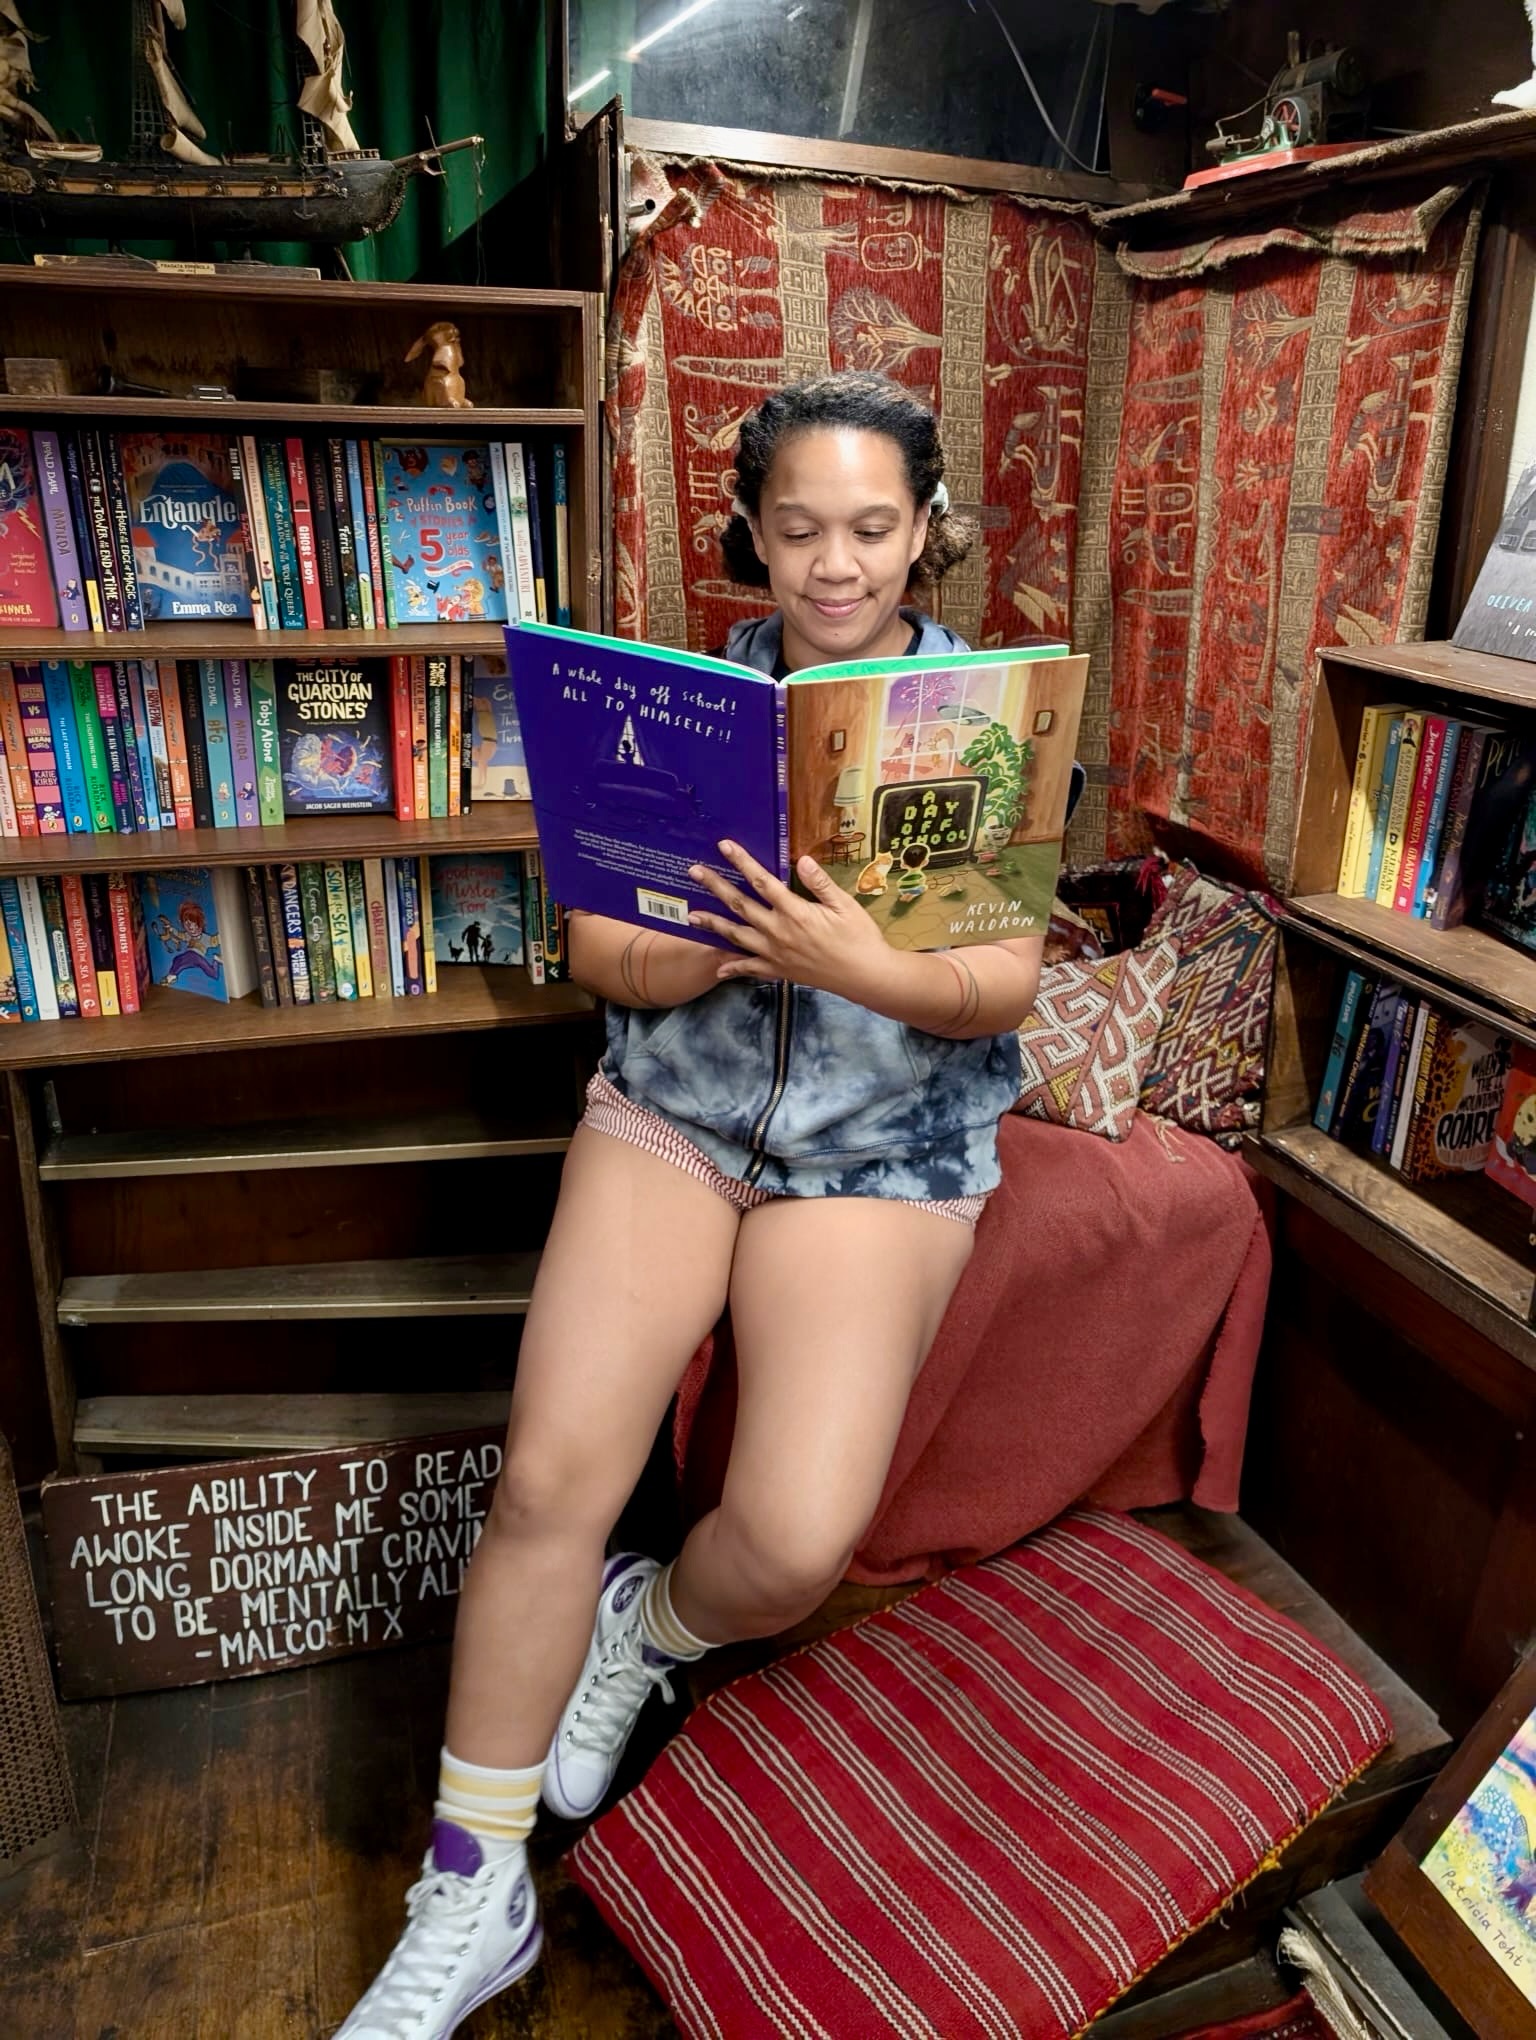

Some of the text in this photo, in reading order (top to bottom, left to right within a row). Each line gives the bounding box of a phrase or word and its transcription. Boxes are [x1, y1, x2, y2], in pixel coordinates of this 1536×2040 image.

[41, 440, 58, 494] ROALD DAHL
[231, 465, 241, 480] Fine
[314, 476, 326, 511] GARNER
[406, 496, 478, 512] Puffin Book
[93, 507, 107, 539] TOWER
[114, 509, 129, 536] HOUSE
[140, 494, 239, 530] Entangle
[51, 507, 71, 556] MATILDA
[337, 524, 353, 555] Ferris
[353, 519, 364, 541] CAY
[99, 548, 111, 568] END
[120, 544, 131, 564] EDGE
[297, 524, 315, 585] GHOST BOYS
[368, 525, 380, 570] NANOOK
[381, 534, 391, 565] CLAW
[419, 528, 446, 564] 5
[273, 511, 295, 616] SHADOW WOLF QUEEN
[172, 601, 237, 616] Emma Rea
[1486, 594, 1534, 613] OLIVER
[296, 669, 363, 683] THE CITY OF
[414, 659, 425, 695] SURVIVE
[552, 662, 737, 716] A whole day off school!
[118, 688, 129, 709] DAHL
[207, 685, 217, 706] DAHL
[232, 687, 242, 708] DAHL
[288, 683, 372, 703] GUARDIAN
[416, 696, 424, 706] IN
[28, 704, 41, 716] VS
[146, 688, 162, 728] BRAVEPAW
[297, 702, 369, 720] STONES
[417, 707, 425, 725] TIME
[563, 685, 732, 744] ALL TO HIMSELF!!
[106, 725, 115, 736] THE
[232, 719, 249, 761] MATILDA
[255, 698, 275, 762] Toby Alone
[34, 770, 56, 779] KATIE
[110, 750, 121, 772] SCHOOL
[35, 777, 58, 786] KIRBY
[89, 775, 102, 811] RIORDAN
[904, 801, 959, 820] DAY
[922, 789, 936, 805] A
[890, 829, 968, 850] SCHOOL
[901, 817, 953, 835] OFF
[1400, 799, 1425, 889] GANGSTA GRANNY
[1383, 848, 1398, 891] KIERAN
[280, 879, 302, 933] DANCERS
[305, 887, 322, 913] Green
[326, 869, 349, 936] SON SEA
[967, 899, 1023, 917] KEVIN
[116, 905, 126, 932] ISLAND
[370, 900, 384, 936] CHARLIE
[950, 915, 1034, 934] WALDRON
[72, 917, 87, 951] BENEATH
[79, 963, 89, 979] SEA
[290, 952, 299, 973] VICK
[296, 949, 306, 975] CHRIS
[1348, 1060, 1360, 1083] CHILD
[1436, 1108, 1498, 1150] ROARE
[91, 1444, 502, 1527] THE ABILITY TO READ
[70, 1482, 486, 1569] AWOKE INSIDE ME SOME
[86, 1562, 192, 1608] LONG
[210, 1537, 364, 1594] DORMANT
[104, 1556, 472, 1645] TO BE MENTALLY ALI
[382, 1605, 404, 1641] X
[1441, 1868, 1524, 1967] Patricia Toht
